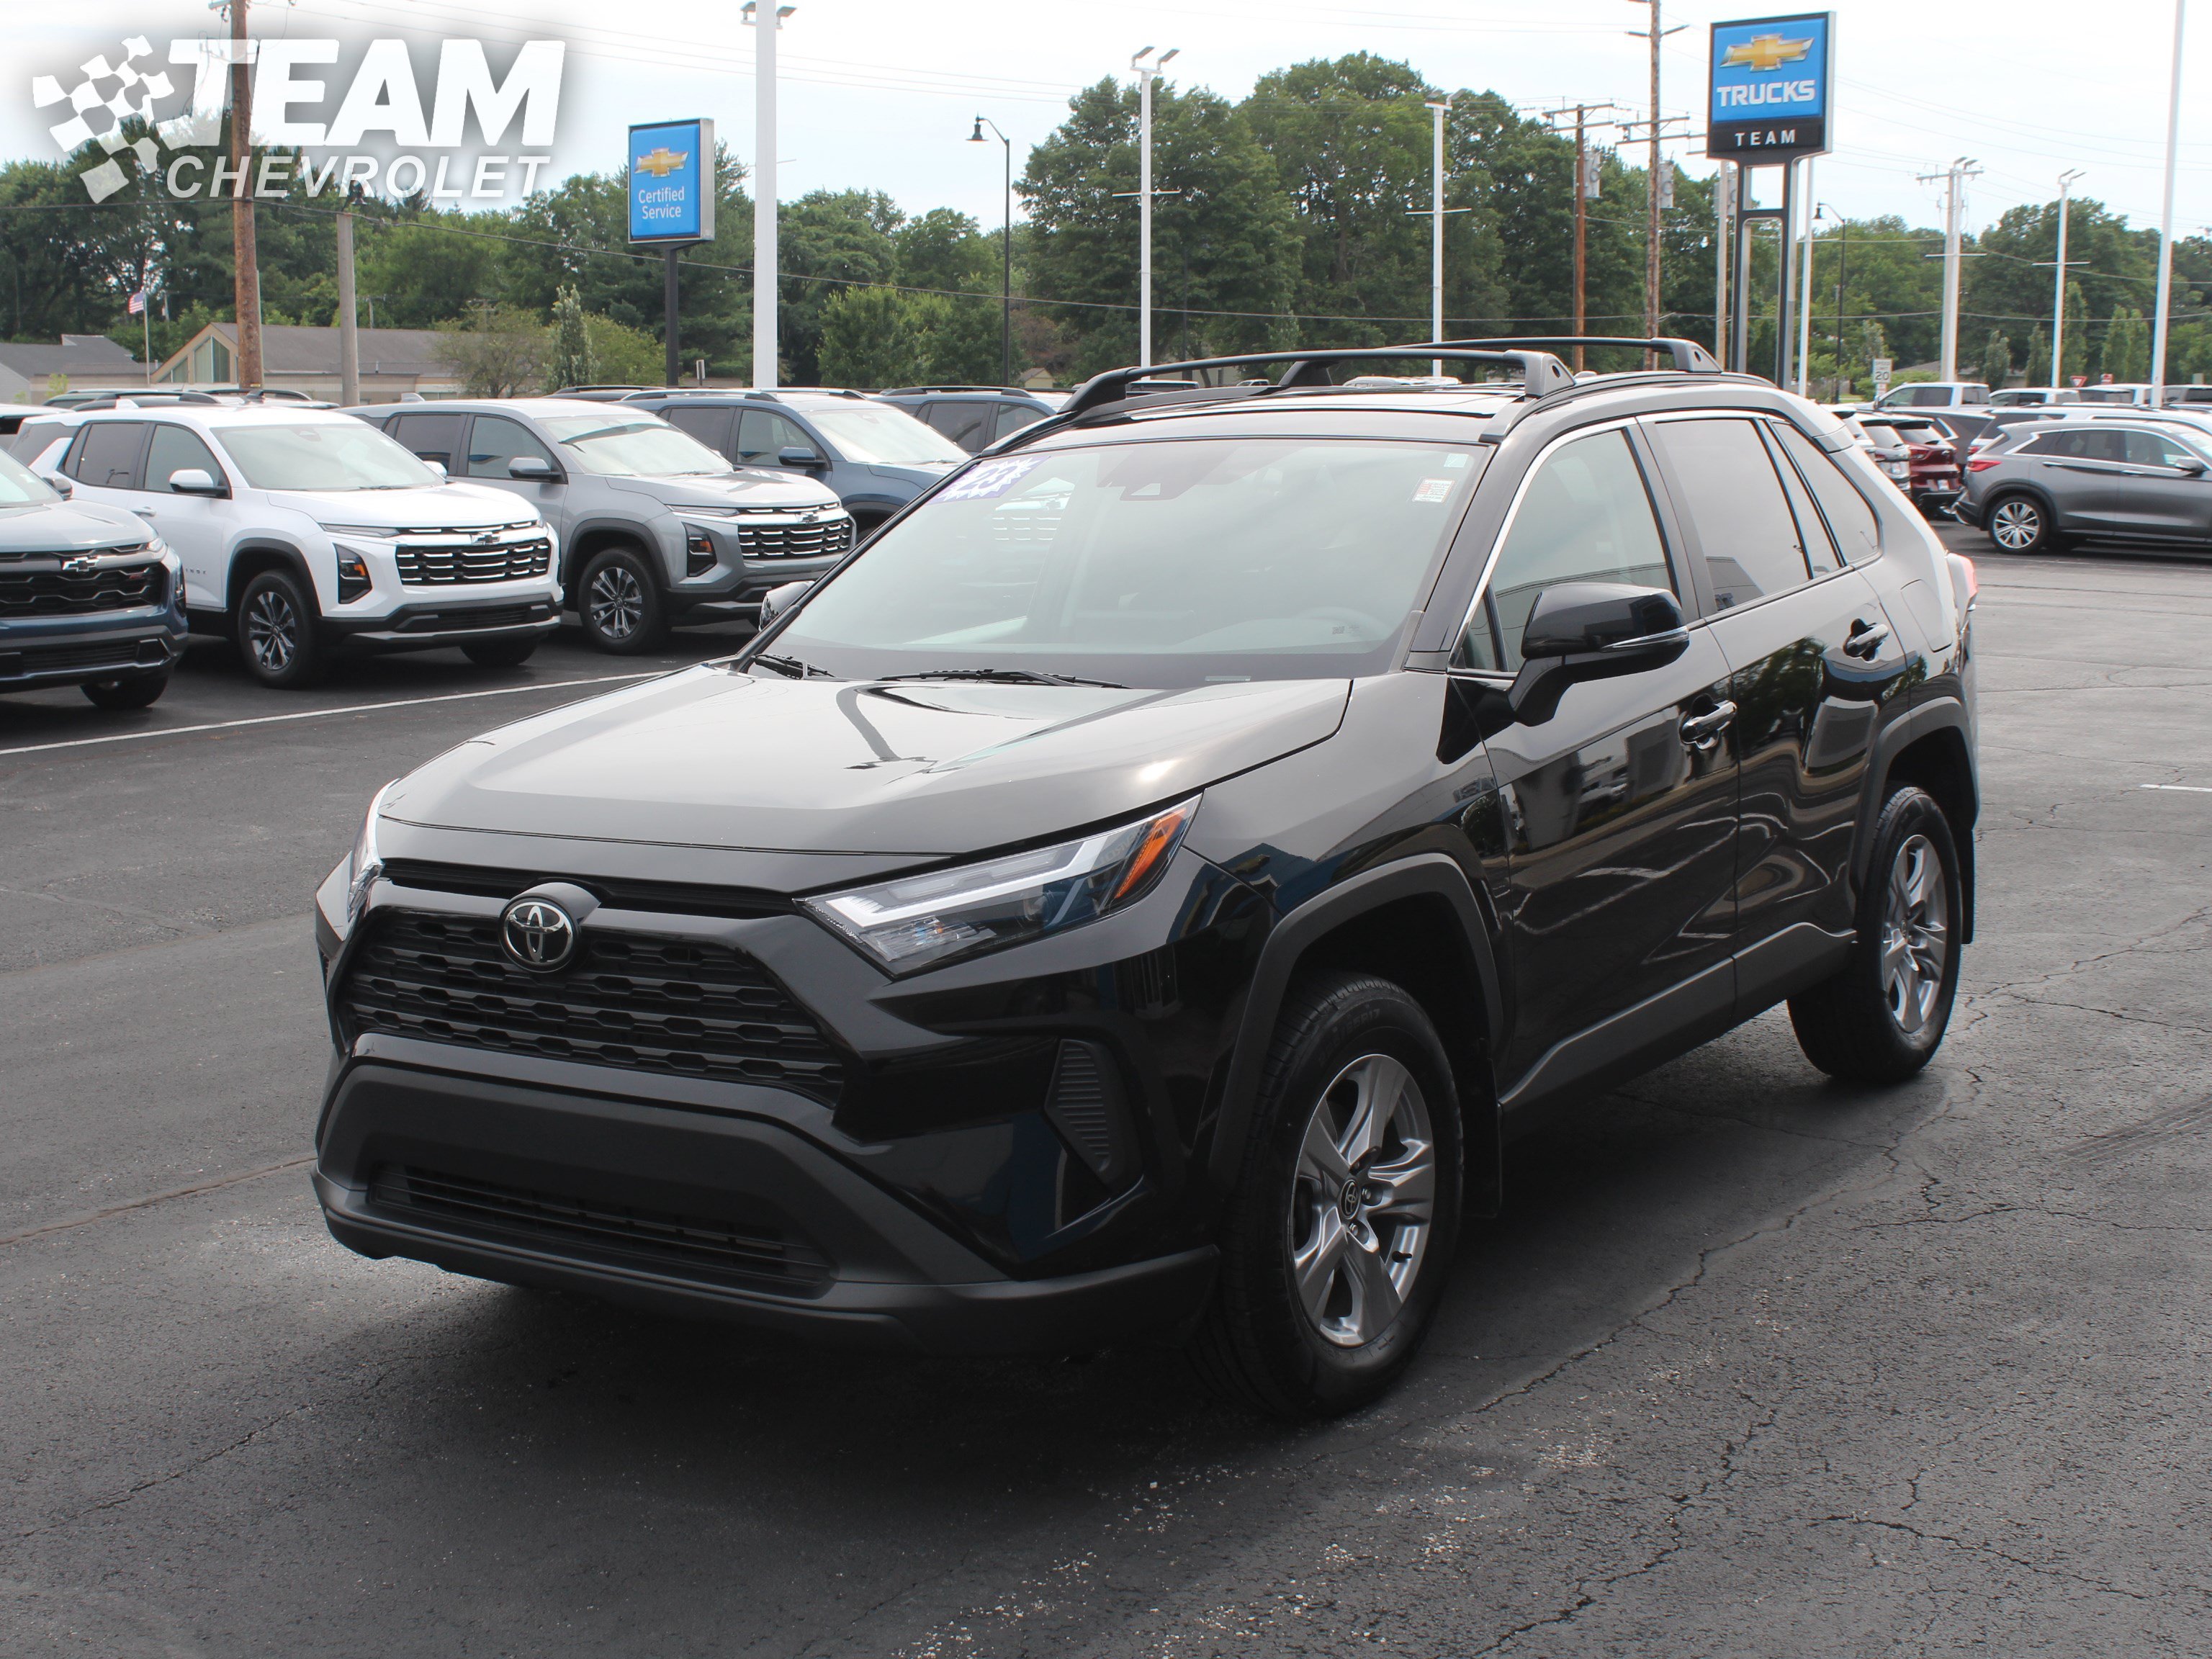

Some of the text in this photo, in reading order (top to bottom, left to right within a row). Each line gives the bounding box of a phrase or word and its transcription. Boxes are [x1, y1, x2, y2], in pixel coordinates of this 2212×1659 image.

[1717, 79, 1816, 107] TRUCKS
[1735, 129, 1797, 147] TEAM
[638, 186, 685, 204] Certified
[642, 204, 682, 220] Service
[1875, 371, 1890, 380] 20
[956, 464, 1019, 492] 23
